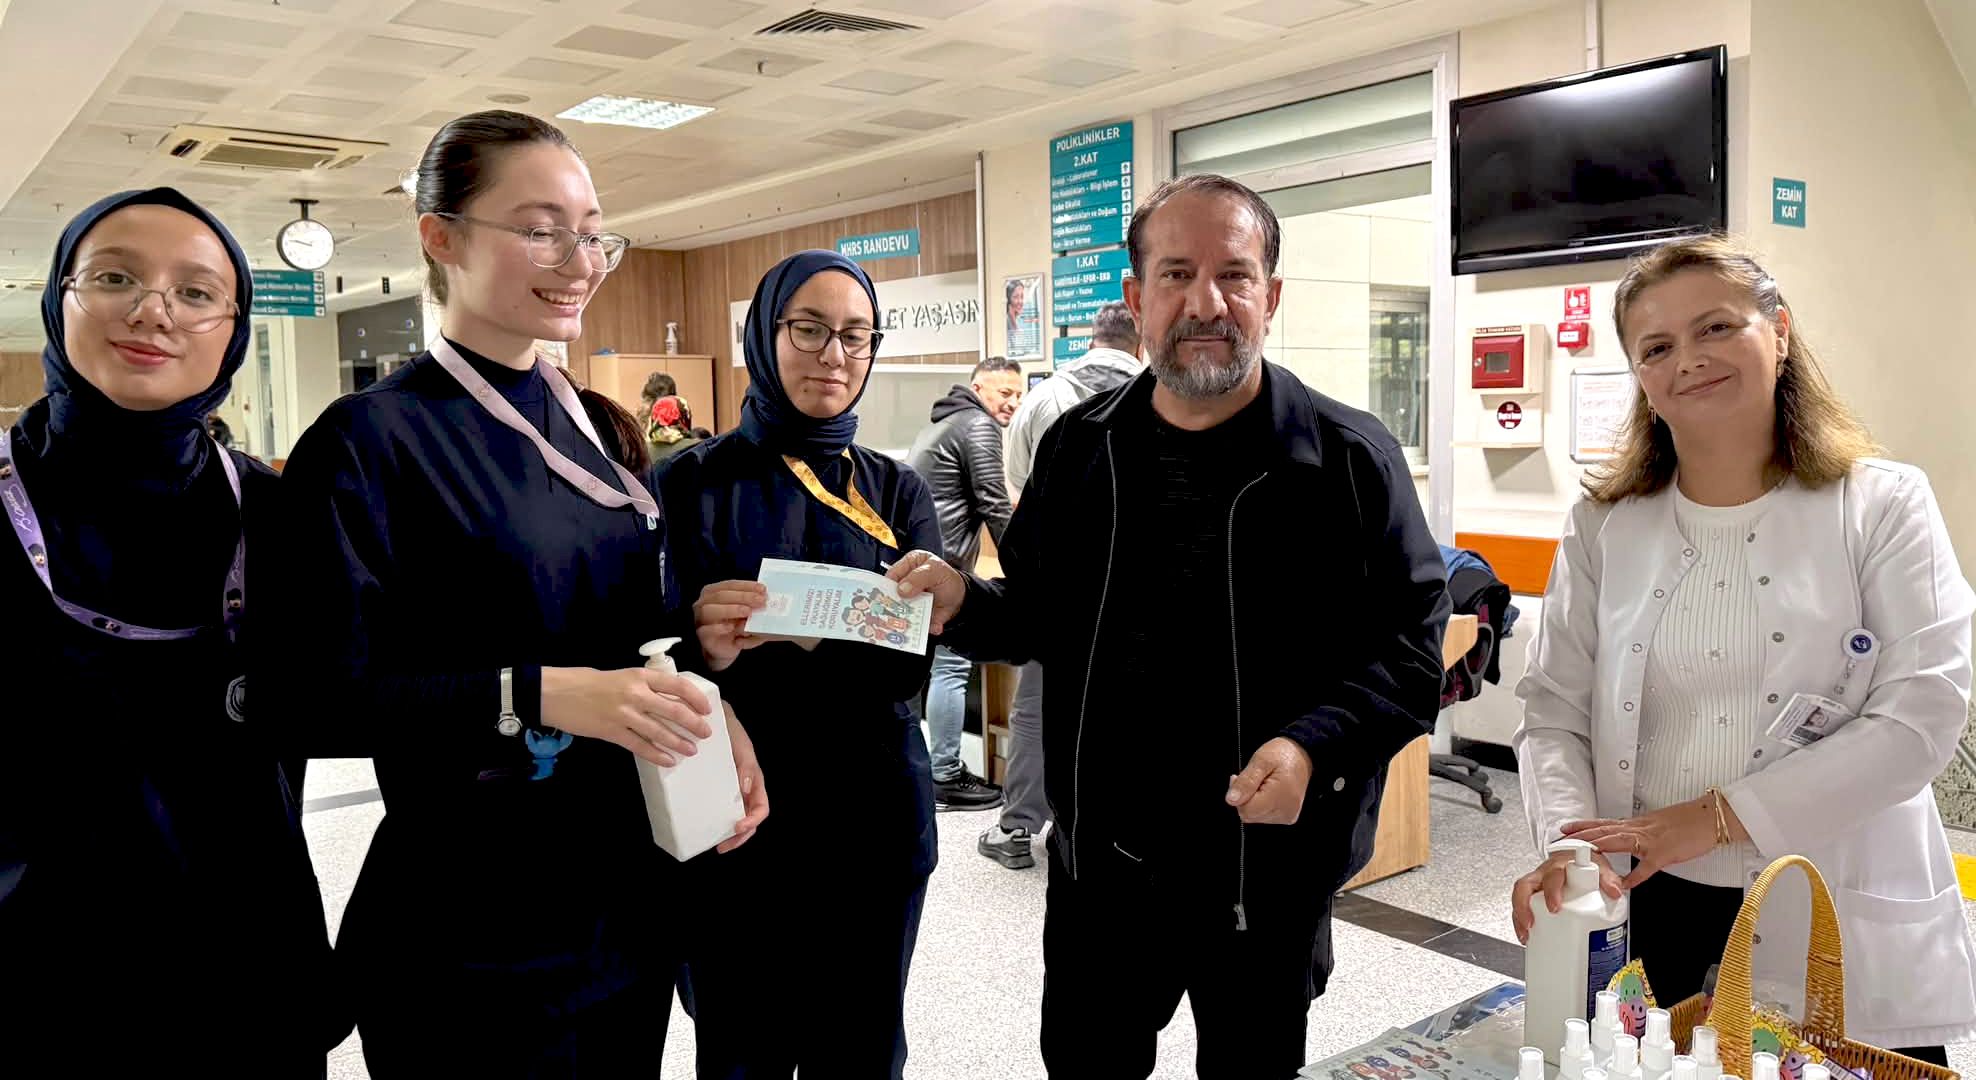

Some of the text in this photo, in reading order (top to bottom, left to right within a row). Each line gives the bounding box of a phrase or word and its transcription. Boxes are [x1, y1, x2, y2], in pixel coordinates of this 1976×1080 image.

[1056, 127, 1120, 152] POLİKLİNİKLER
[1073, 152, 1098, 167] 2.KAT
[1776, 185, 1802, 203] ZEMİN
[1781, 205, 1797, 219] KAT
[841, 234, 909, 257] MHRS RANDEVU
[1076, 255, 1099, 268] 1.KAT
[911, 298, 979, 332] YAŞASIN
